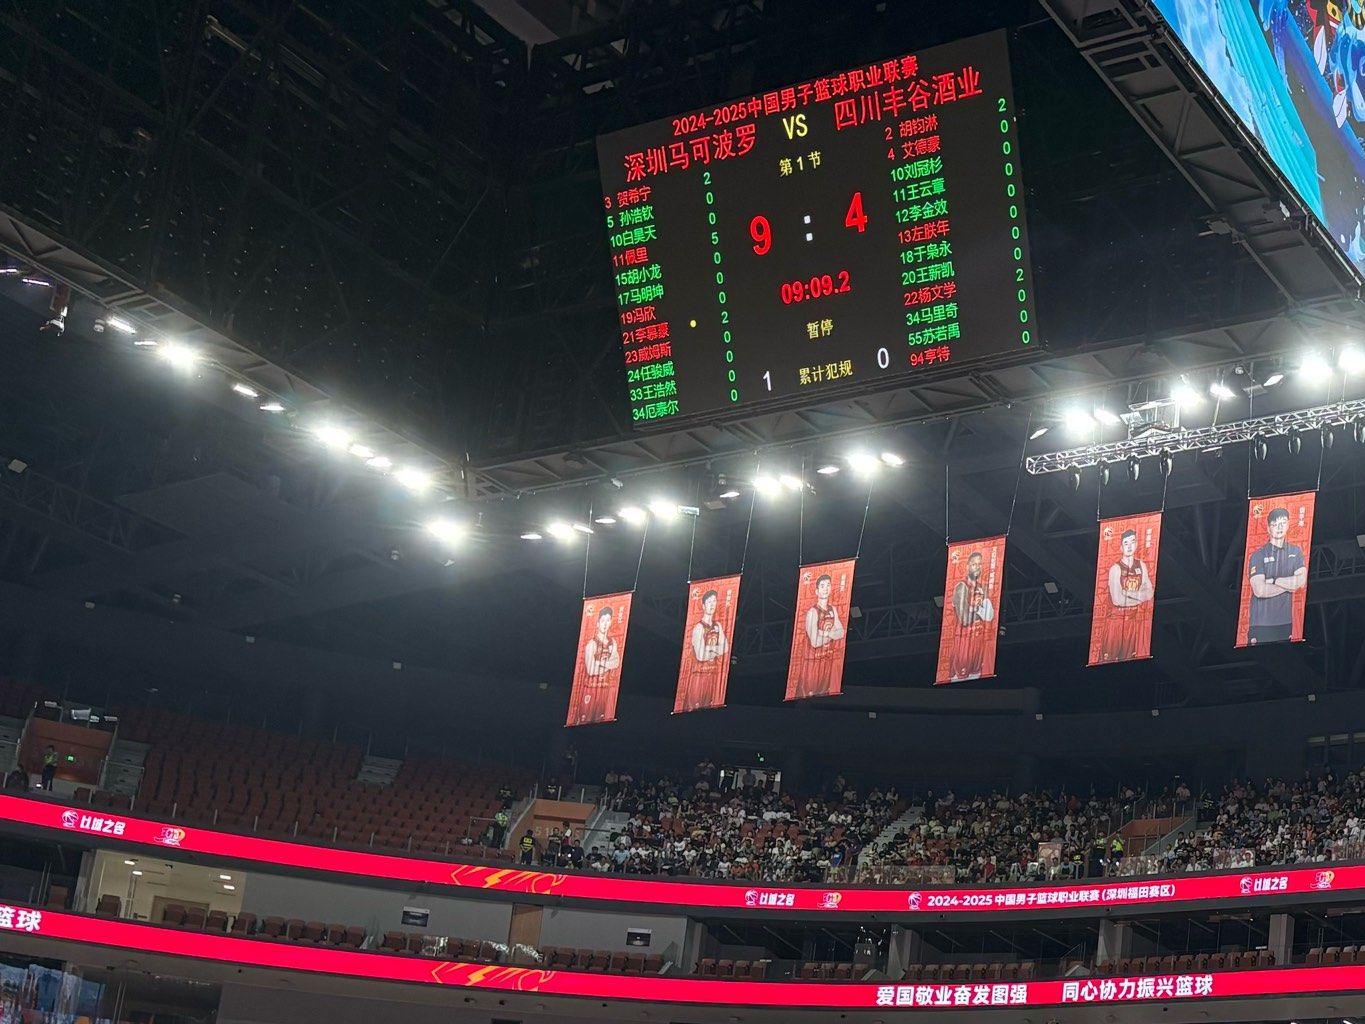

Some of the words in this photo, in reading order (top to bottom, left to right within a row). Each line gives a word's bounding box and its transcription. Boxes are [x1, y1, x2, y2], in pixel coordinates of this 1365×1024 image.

[834, 66, 983, 131] 四川丰谷酒业
[885, 127, 893, 141] 2
[998, 98, 1006, 112] 2
[782, 114, 809, 140] VS
[887, 148, 895, 160] 4
[1000, 120, 1008, 133] 0
[624, 123, 757, 182] 深圳马可波罗
[1003, 141, 1011, 155] 0
[1005, 163, 1013, 176] 0
[604, 196, 612, 209] 3
[617, 185, 652, 208] 贺希宁
[703, 172, 711, 185] 2
[1007, 184, 1015, 197] 0
[607, 216, 614, 228] 5
[706, 192, 714, 204] 0
[1010, 205, 1018, 218] 0
[709, 212, 716, 225] 0
[750, 215, 772, 256] 9
[845, 192, 868, 232] 4
[711, 232, 719, 244] 5
[1012, 226, 1020, 239] 0
[714, 252, 721, 264] 0
[1014, 247, 1021, 260] 0
[716, 271, 724, 284] 0
[1016, 268, 1024, 281] 2
[781, 271, 850, 304] 09:09.2
[1018, 289, 1025, 302] 0
[621, 305, 656, 324] 19冯欣
[719, 291, 726, 304] 0
[721, 311, 729, 324] 2
[1020, 310, 1028, 323] 0
[806, 319, 833, 339] 暂停
[724, 331, 731, 343] 0
[1022, 331, 1030, 344] 0
[726, 350, 733, 362] 0
[877, 348, 889, 369] 0
[799, 360, 852, 385] 累计犯规
[630, 380, 677, 401] 33王浩然
[728, 369, 736, 382] 0
[763, 370, 771, 391] 1
[731, 389, 738, 401] 0
[927, 894, 993, 907] 2024-2025
[876, 985, 1028, 1006] 爱国敬业奋发图强
[1062, 975, 1214, 1002] 同心协力振兴篮球
